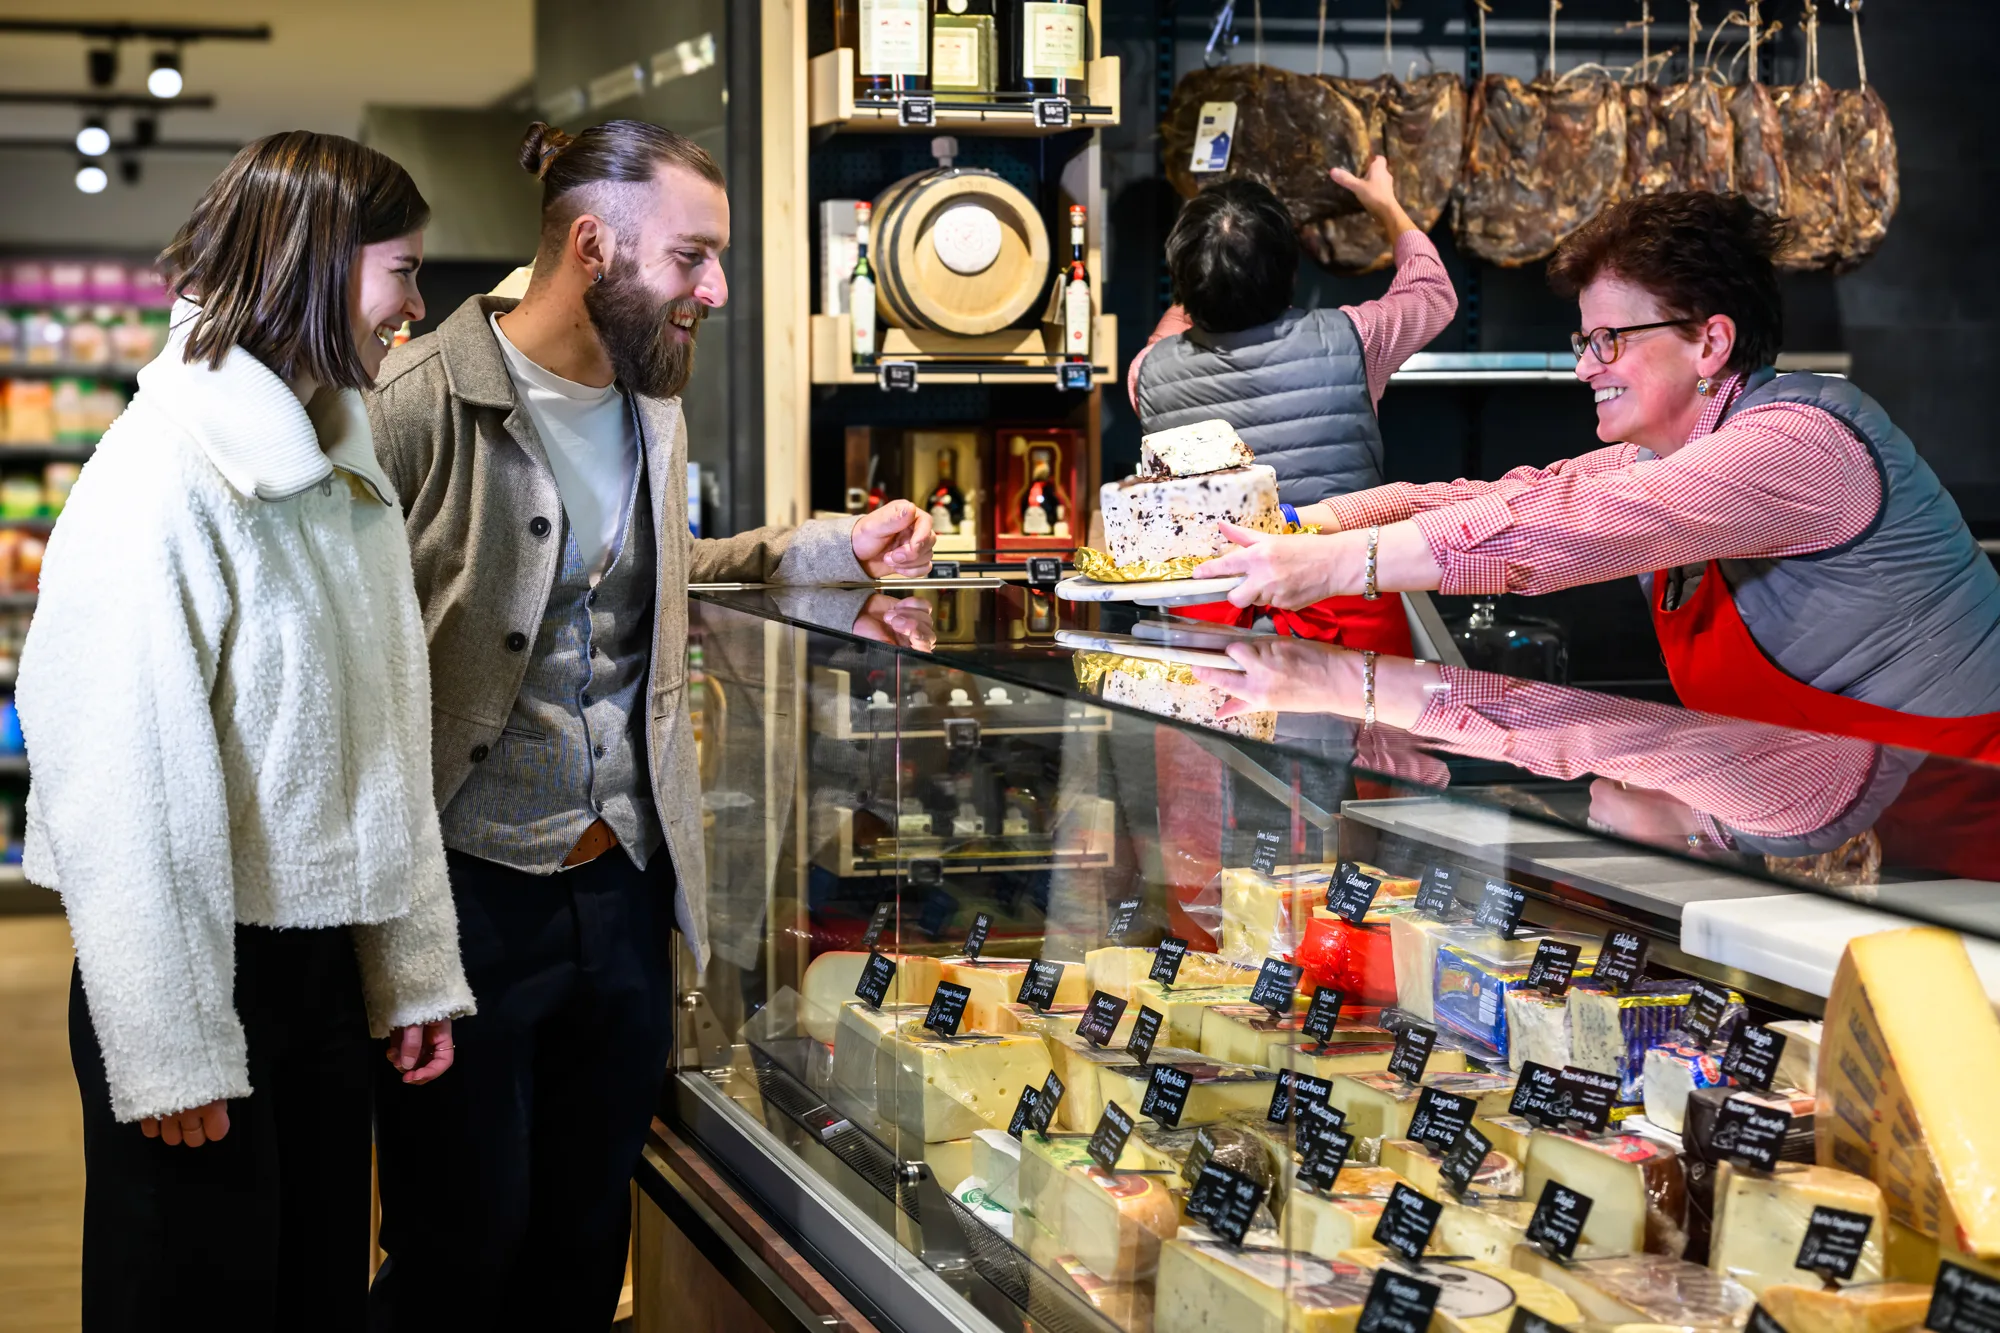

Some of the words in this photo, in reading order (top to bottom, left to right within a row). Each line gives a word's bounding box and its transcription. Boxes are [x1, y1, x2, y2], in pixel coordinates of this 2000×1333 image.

[1346, 873, 1371, 890] Edamer
[1485, 881, 1513, 899] Gorgonzola
[1266, 961, 1279, 973] Alta
[1744, 1025, 1773, 1048] Taleggio
[1155, 1067, 1187, 1089] Pfefferkäse
[1532, 1069, 1556, 1085] Ortler
[1430, 1093, 1460, 1112] Lagrein
